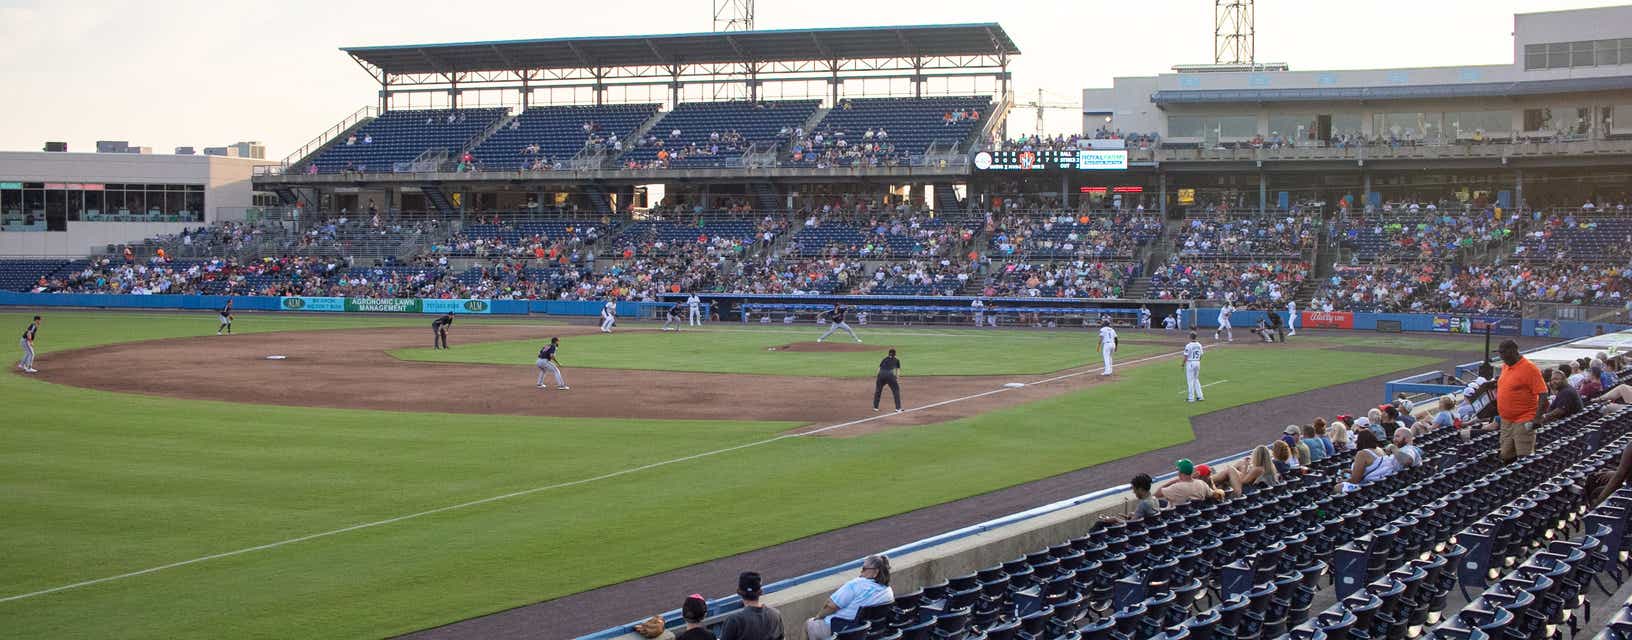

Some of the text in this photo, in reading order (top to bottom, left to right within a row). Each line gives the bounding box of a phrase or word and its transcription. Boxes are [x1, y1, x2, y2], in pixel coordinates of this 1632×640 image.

[288, 298, 301, 307] ALM
[469, 301, 483, 310] ALM
[1192, 350, 1200, 359] 15
